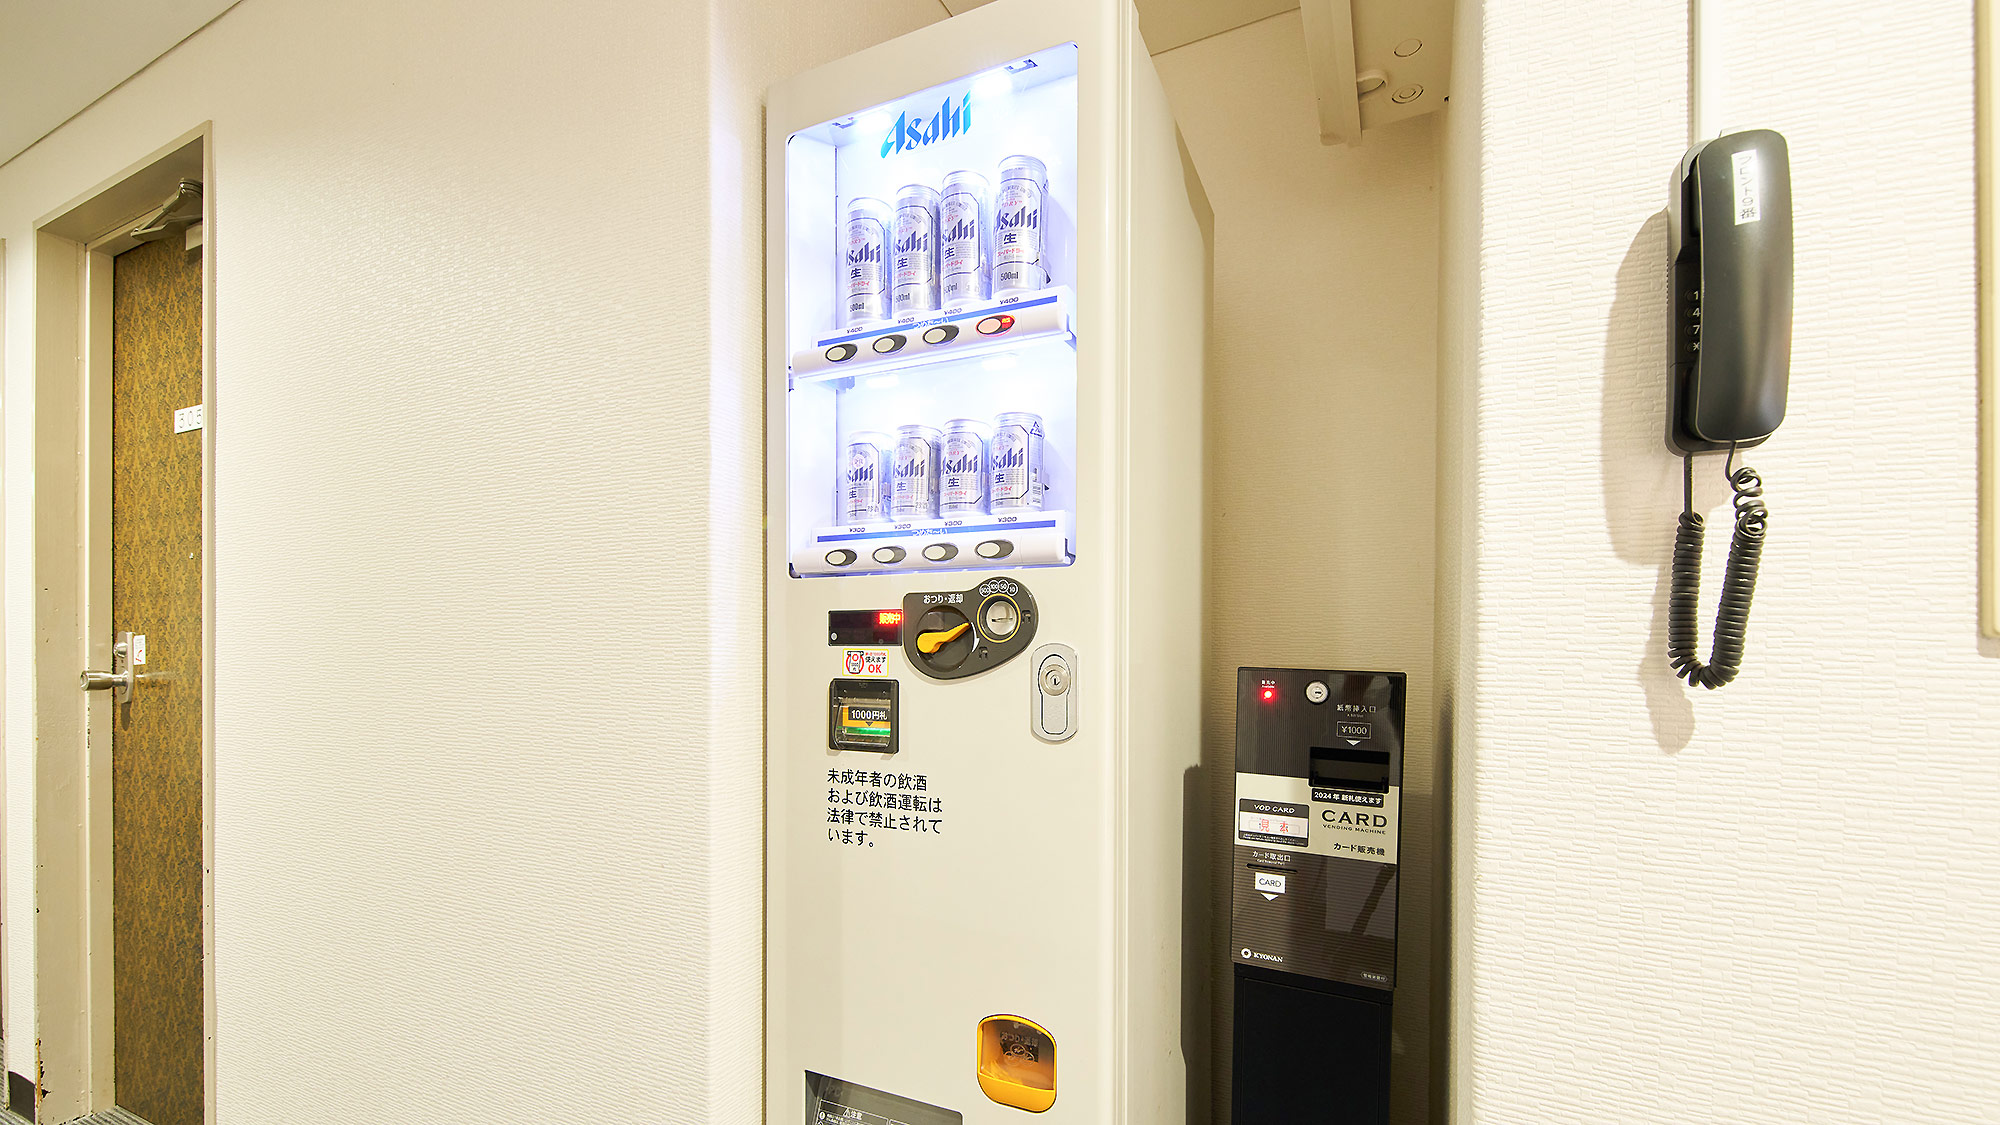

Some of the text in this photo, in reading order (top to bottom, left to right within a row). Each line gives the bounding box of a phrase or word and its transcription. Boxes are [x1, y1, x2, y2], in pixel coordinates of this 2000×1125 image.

[881, 90, 971, 158] Asahi
[1004, 232, 1016, 244] 生
[848, 242, 880, 266] sahi
[945, 247, 955, 259] 生
[897, 258, 908, 269] 生
[851, 268, 861, 279] 生
[1000, 272, 1018, 281] 500ml
[1000, 297, 1019, 305] ¥400
[1694, 291, 1698, 300] 1
[1693, 308, 1700, 316] 4
[847, 326, 863, 334] ¥400
[1693, 325, 1700, 334] 7
[179, 408, 201, 428] 305
[992, 448, 1023, 470] sahi
[948, 477, 959, 487] 生
[995, 473, 1005, 484] 生
[897, 482, 906, 491] 生
[849, 490, 857, 499] 生
[923, 594, 964, 604] おつり・返却
[868, 664, 882, 673] OK
[851, 710, 887, 720] 1000円札
[1341, 726, 1367, 735] ¥1000
[827, 768, 927, 791] 未成年者の飲酒
[827, 788, 942, 813] および飲酒運転は
[827, 807, 942, 834] 法律で禁止されて
[1322, 810, 1387, 827] CARD
[1355, 827, 1386, 835] MACHINE
[828, 828, 874, 848] います。
[1334, 843, 1385, 856] カード販売機
[1252, 851, 1290, 862] カード取出口
[1259, 877, 1281, 888] CARD
[1253, 952, 1283, 963] KYONAN
